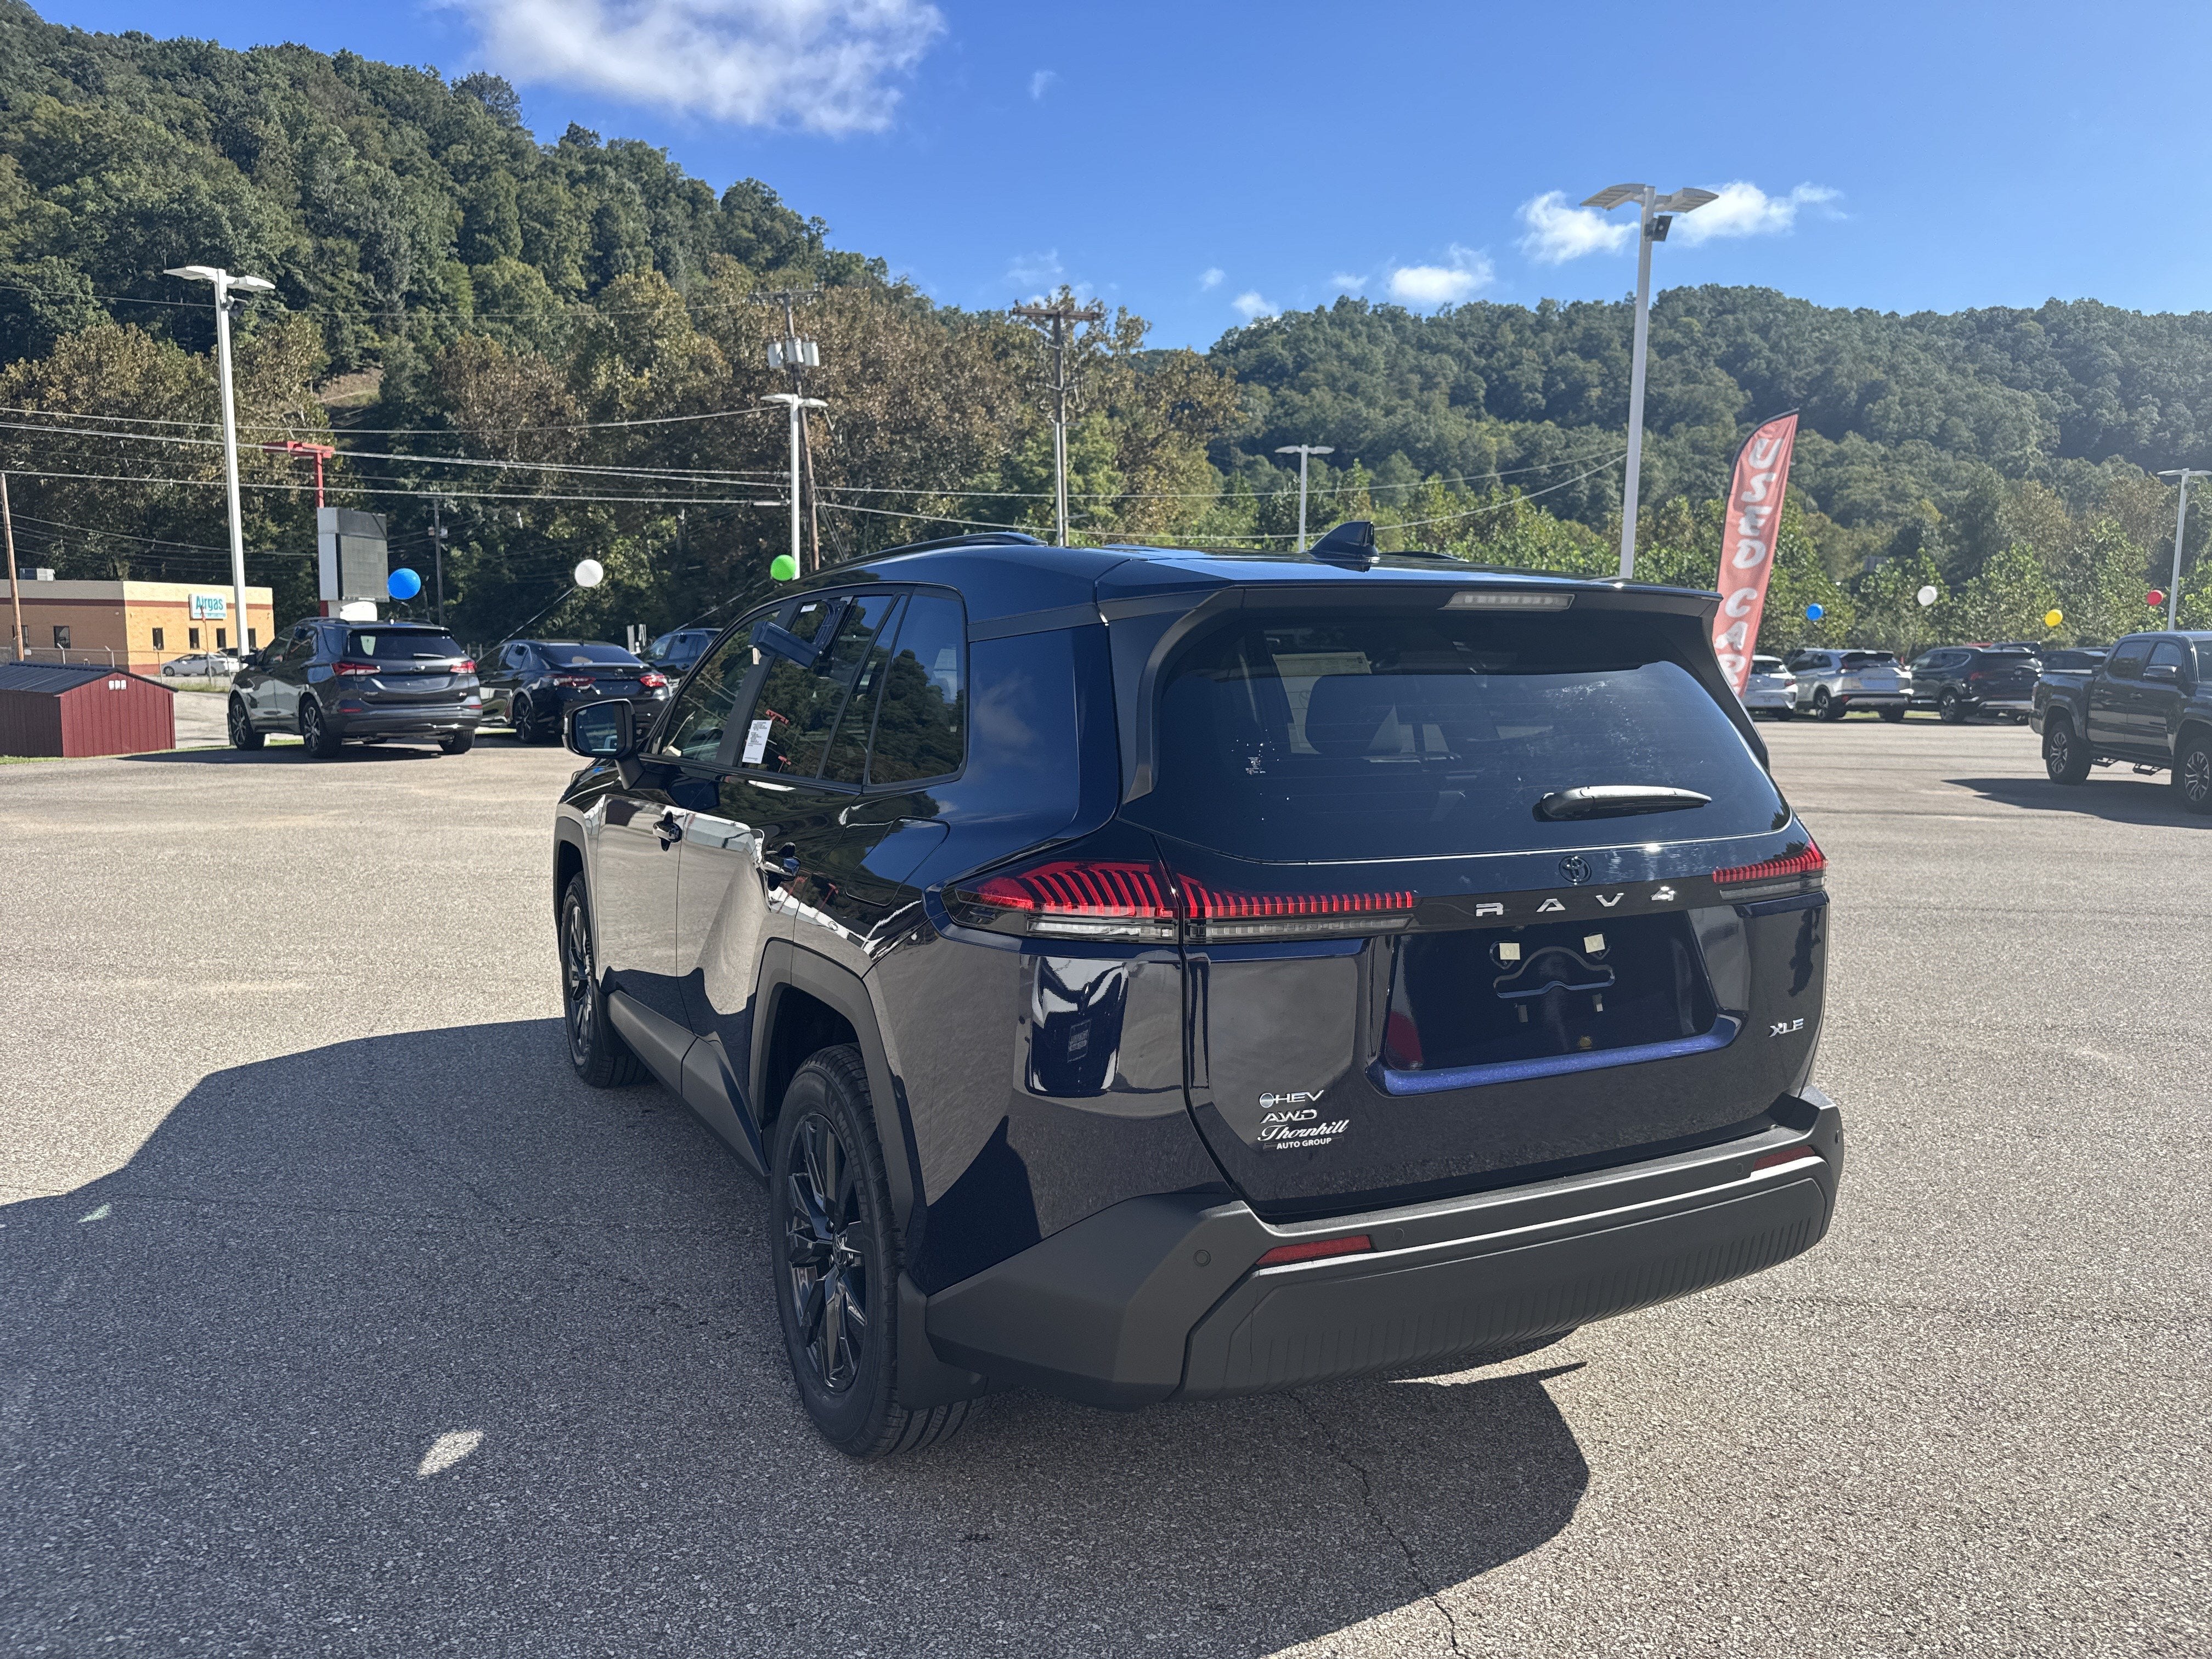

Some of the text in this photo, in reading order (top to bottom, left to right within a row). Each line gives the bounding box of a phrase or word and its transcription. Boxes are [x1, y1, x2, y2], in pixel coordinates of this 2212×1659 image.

[1715, 438, 1782, 695] USED CAR
[196, 595, 223, 611] Airgas
[1476, 886, 1675, 917] RAV4
[1768, 1018, 1804, 1037] XLE
[1276, 1090, 1324, 1104] HEV
[1260, 1109, 1317, 1124] AWD
[1257, 1119, 1350, 1141] Thornhill
[1276, 1137, 1332, 1150] AUTO GROUP
[837, 1111, 871, 1224] MICHELIN
